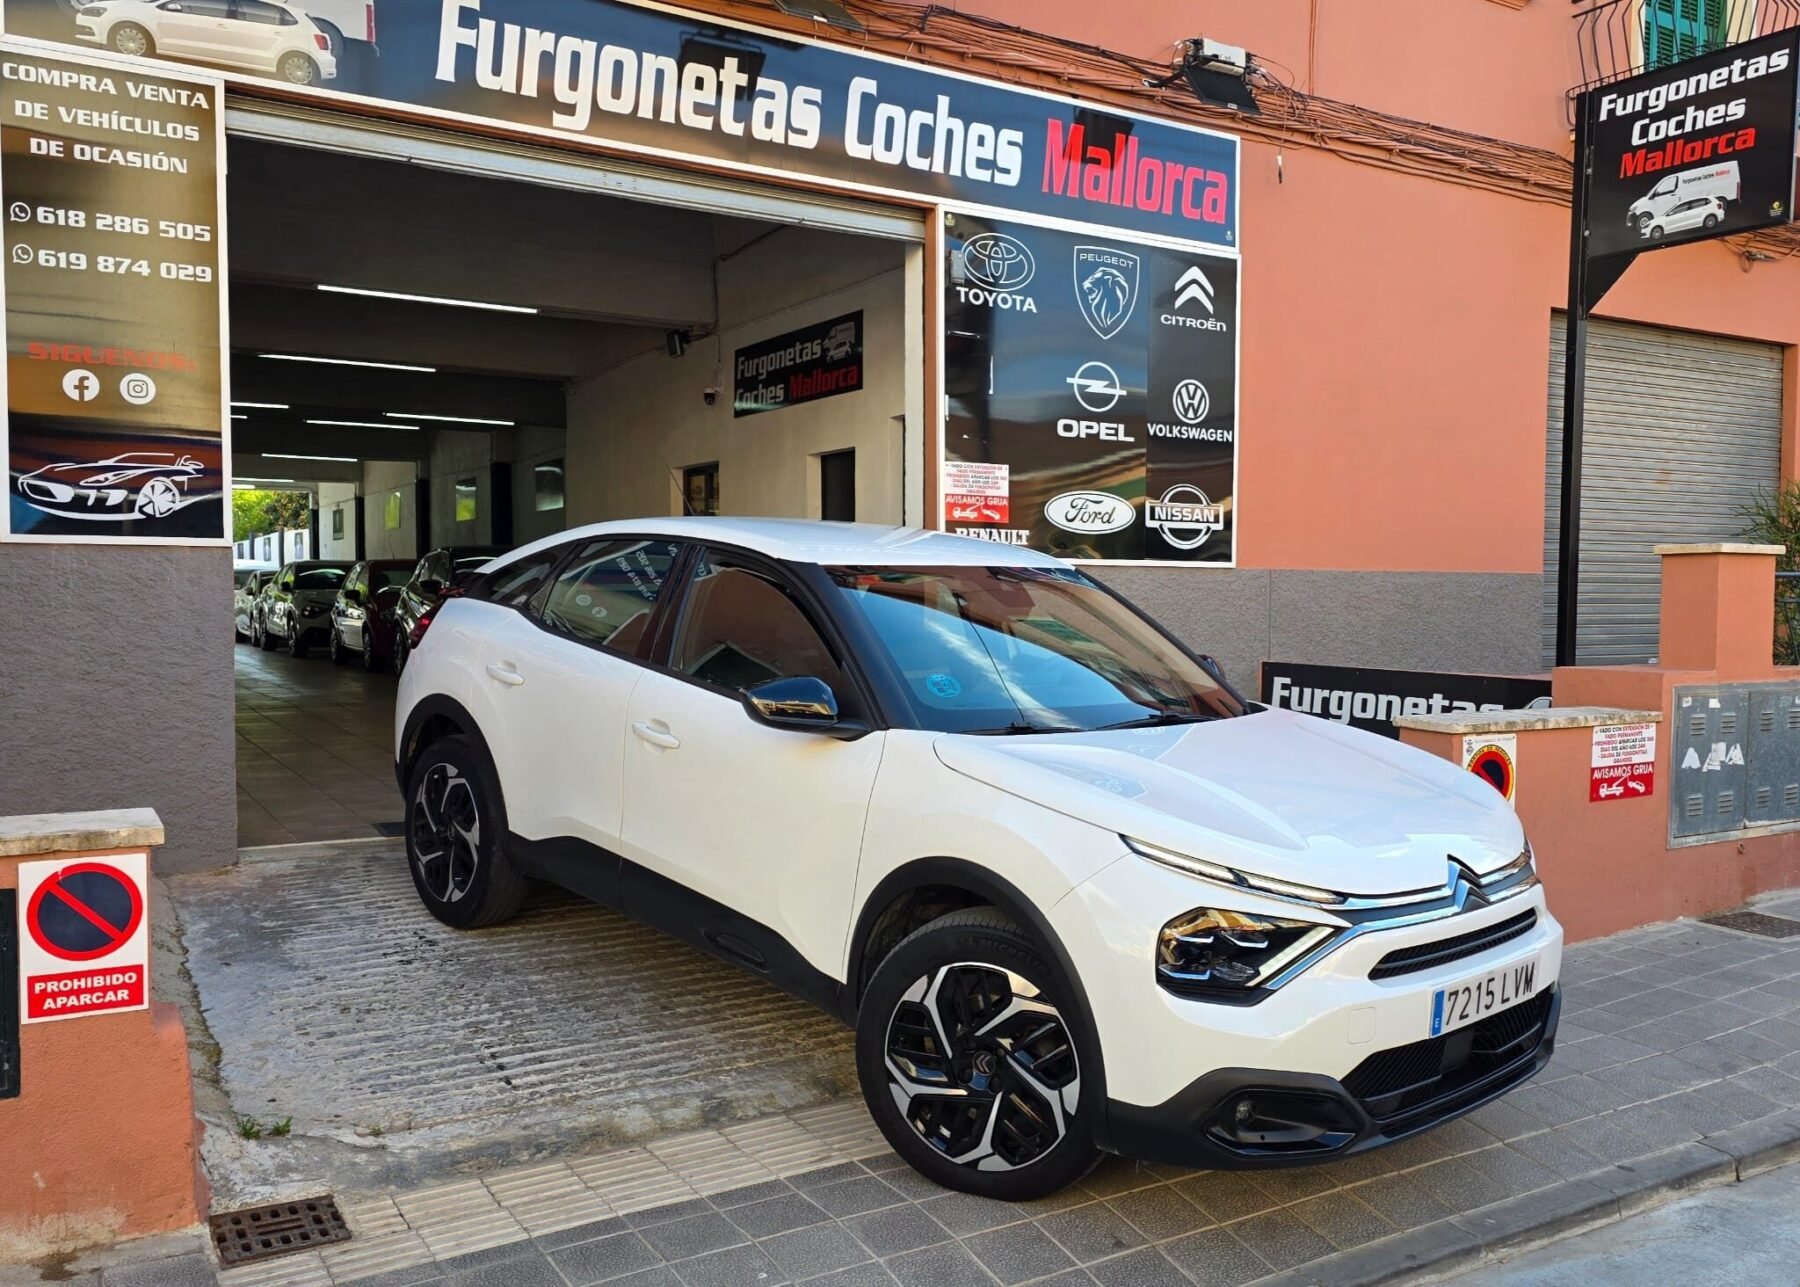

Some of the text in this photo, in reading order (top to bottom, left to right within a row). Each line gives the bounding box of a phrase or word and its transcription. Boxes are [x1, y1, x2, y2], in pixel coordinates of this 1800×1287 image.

[2, 62, 210, 109] COMPRA VENTA
[1599, 48, 1790, 122] Furgonetas
[14, 99, 200, 142] DE VEHÍCULOS
[435, 0, 1228, 225] Furgonetas Coches Mallorca
[1631, 98, 1747, 146] Coches
[30, 137, 188, 174] DE OCASIÓN
[1619, 127, 1756, 179] Mallorca
[36, 206, 211, 242] 618 286 505
[38, 249, 212, 283] 619 874 029
[1079, 253, 1134, 268] PEUGEOT
[956, 286, 1038, 313] TOYOTA
[737, 339, 822, 380] Furgonetas
[789, 366, 858, 399] Mallorca
[1057, 418, 1135, 442] OPEL
[1147, 422, 1233, 442] VOLKSWAGEN
[946, 495, 1008, 506] AVISAMOS GRUA
[1064, 496, 1116, 526] Ford
[1155, 506, 1215, 522] NISSAN
[1592, 763, 1653, 779] AVISAMOS GRUA
[34, 972, 137, 994] PROHIBIDO
[42, 989, 130, 1010] APARCAR
[1445, 961, 1536, 1026] 7215 LVM
